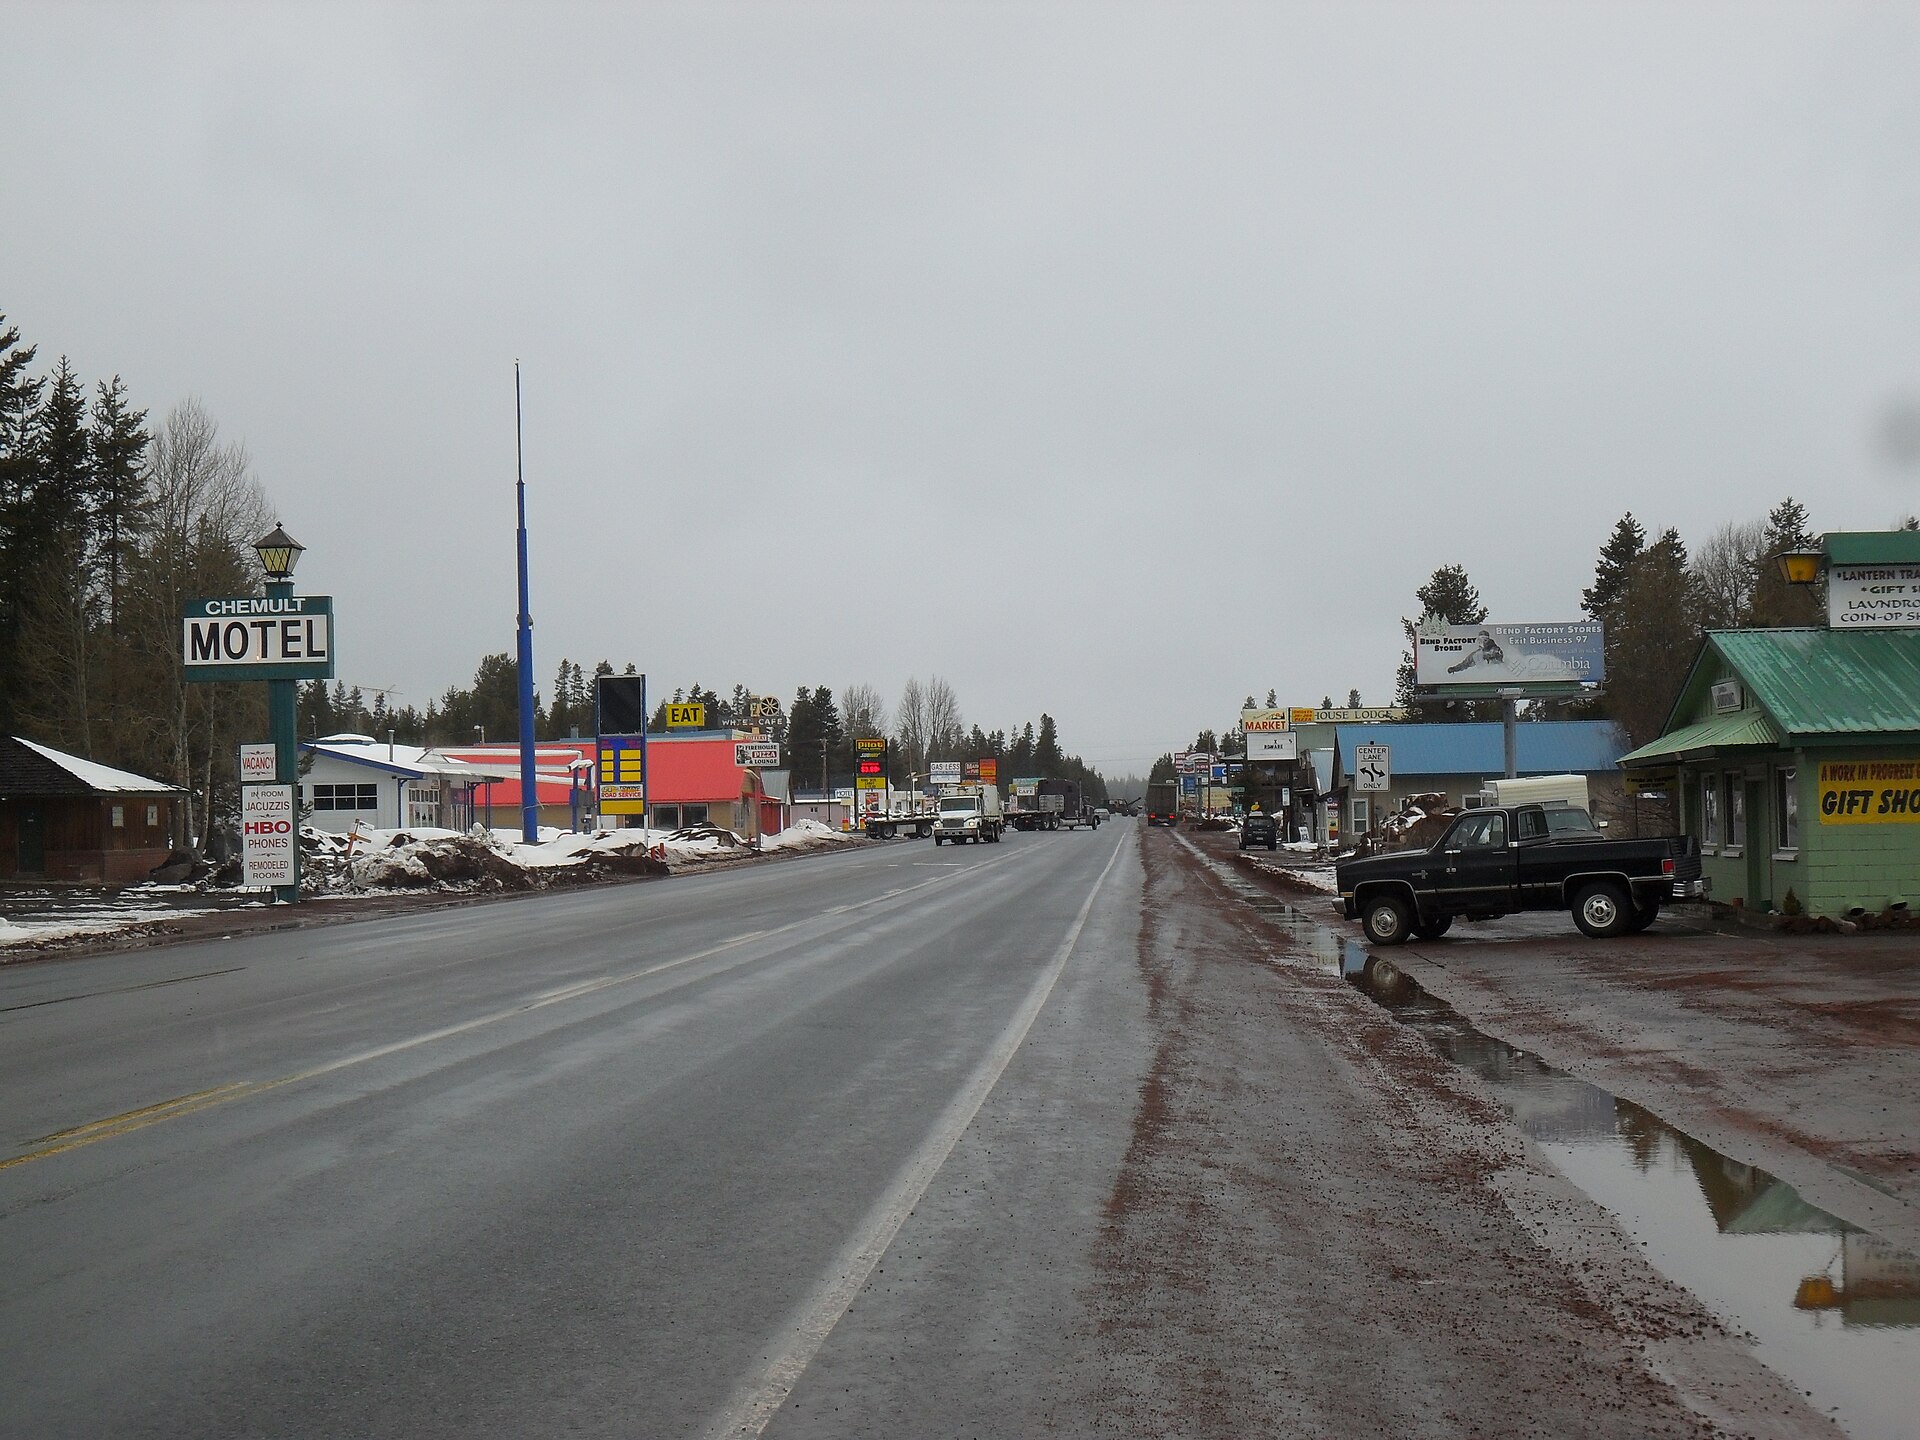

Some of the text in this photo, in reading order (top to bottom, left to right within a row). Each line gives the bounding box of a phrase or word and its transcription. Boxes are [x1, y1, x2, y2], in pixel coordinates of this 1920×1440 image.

[1842, 570, 1896, 581] LANTERN
[1869, 585, 1906, 594] GIFT
[205, 598, 306, 615] CHEMULT
[1840, 612, 1903, 622] COIN-OP
[1496, 625, 1602, 635] BEND FACTORY STORES
[190, 619, 326, 661] MOTEL
[1443, 637, 1477, 645] FACTORY
[1509, 635, 1588, 645] Exit Business 97
[1434, 644, 1463, 652] STORES
[671, 707, 700, 723] EAT
[758, 718, 783, 726] CAFE
[1245, 720, 1286, 731] MARKET
[242, 756, 275, 771] VACANCY
[931, 763, 943, 771] GAS
[945, 763, 960, 771] LESS
[1821, 765, 1827, 781] A
[1857, 764, 1868, 780] IN
[244, 801, 290, 811] JACUZZIS
[1821, 789, 1874, 816] GIFT
[244, 820, 291, 835] HBO
[248, 838, 289, 849] PHONES
[248, 860, 289, 870] REMODELED
